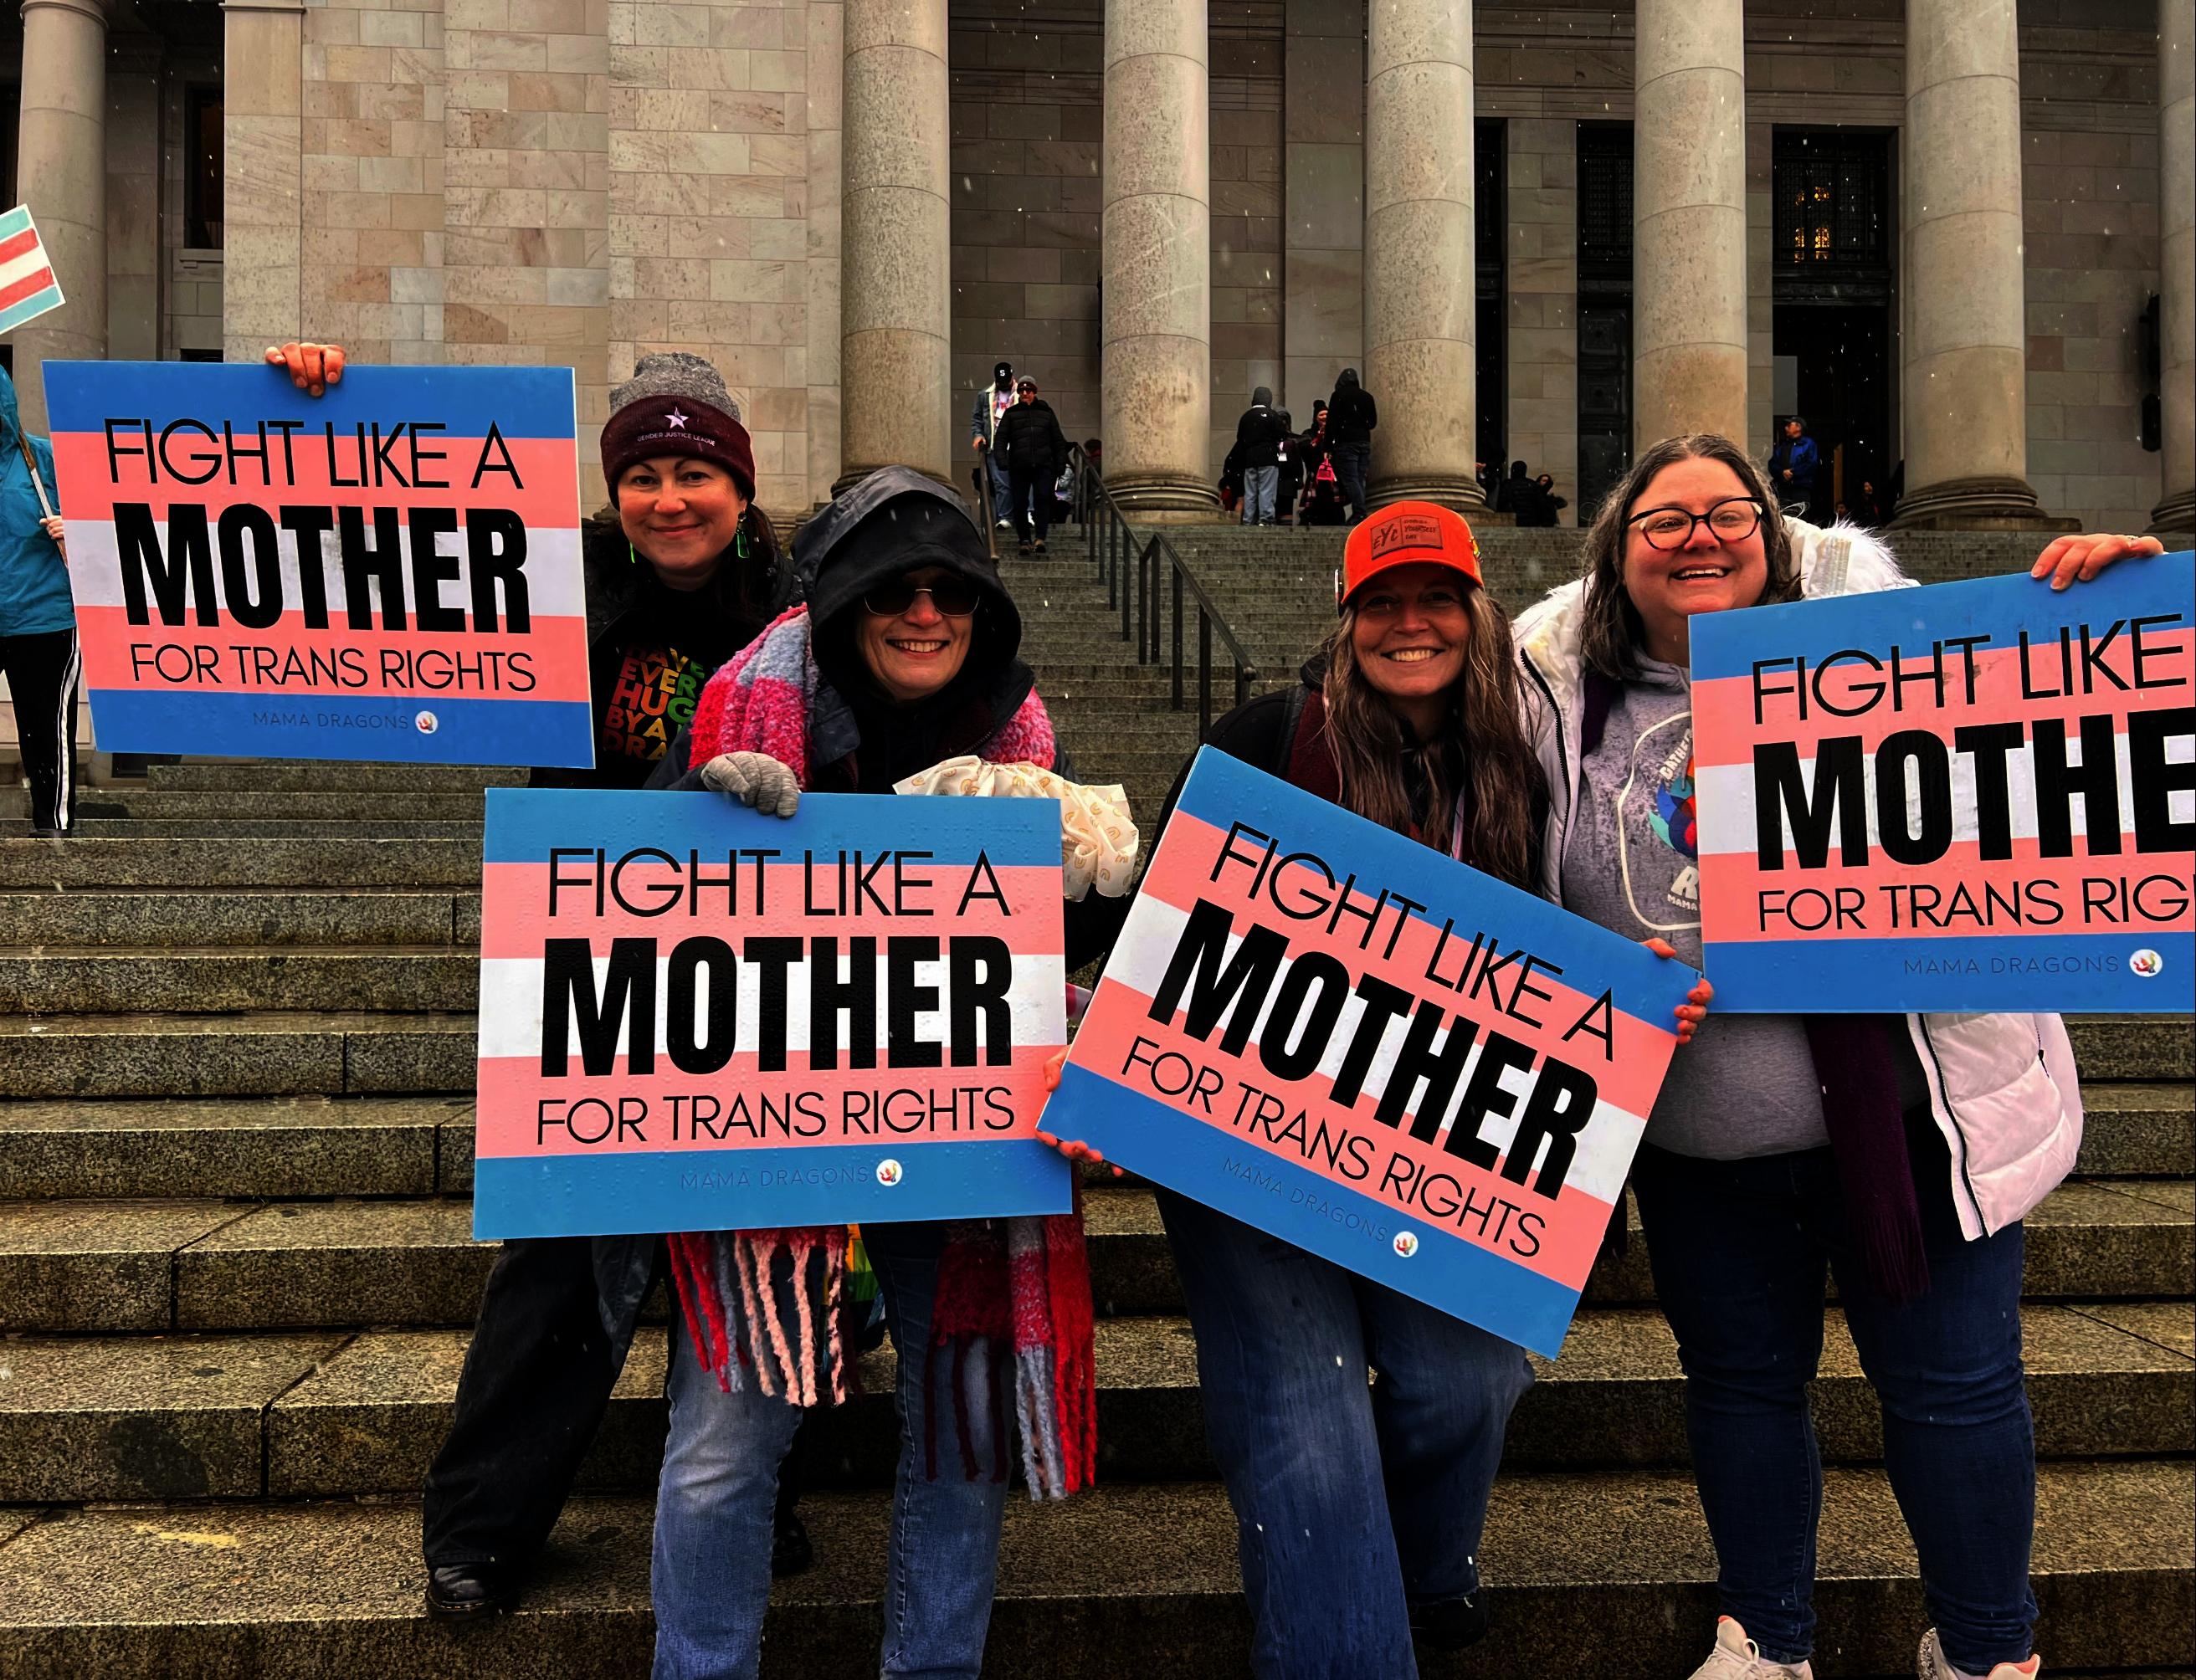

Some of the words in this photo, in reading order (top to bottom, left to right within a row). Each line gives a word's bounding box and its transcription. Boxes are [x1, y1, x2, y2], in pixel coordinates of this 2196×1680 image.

[105, 418, 304, 485] FIGHT
[326, 422, 449, 488] LIKE
[471, 421, 524, 489] A
[638, 433, 664, 442] GENDER
[693, 435, 716, 447] LEAGUE
[113, 503, 531, 633] MOTHER
[131, 644, 222, 683] FOR
[229, 646, 367, 687] TRANS
[380, 650, 536, 691] RIGHTS
[619, 656, 697, 699] EVER
[1753, 635, 1990, 724] FIGHT
[2019, 613, 2187, 699] LIKE
[254, 712, 310, 726] MAMA
[317, 714, 408, 729] DRAGONS
[604, 704, 646, 734] BY
[642, 718, 668, 741] A
[549, 848, 780, 917] FIGHT
[805, 850, 933, 915] LIKE
[957, 849, 1011, 915] A
[1668, 894, 1698, 910] MAMA
[1759, 888, 1866, 931] FOR
[1880, 880, 2063, 928] TRANS
[2082, 875, 2194, 923] RIG
[1210, 821, 1427, 960] FIGHT
[1425, 918, 1563, 1029] LIKE
[1562, 987, 1613, 1062] A
[1904, 958, 1980, 975] MAMA
[1991, 955, 2119, 973] DRAGONS
[541, 936, 1012, 1077] MOTHER
[1147, 898, 1597, 1201] MOTHER
[538, 1098, 648, 1145] FOR
[664, 1092, 826, 1140] TRANS
[844, 1087, 1013, 1134] RIGHTS
[1122, 1036, 1223, 1114] FOR
[1234, 1082, 1374, 1180] TRANS
[1380, 1152, 1545, 1257] RIGHTS
[681, 1171, 751, 1190] MAMA
[761, 1167, 868, 1186] DRAGONS
[1223, 1157, 1282, 1196] MAMA
[1290, 1188, 1388, 1242] DRAGONS
